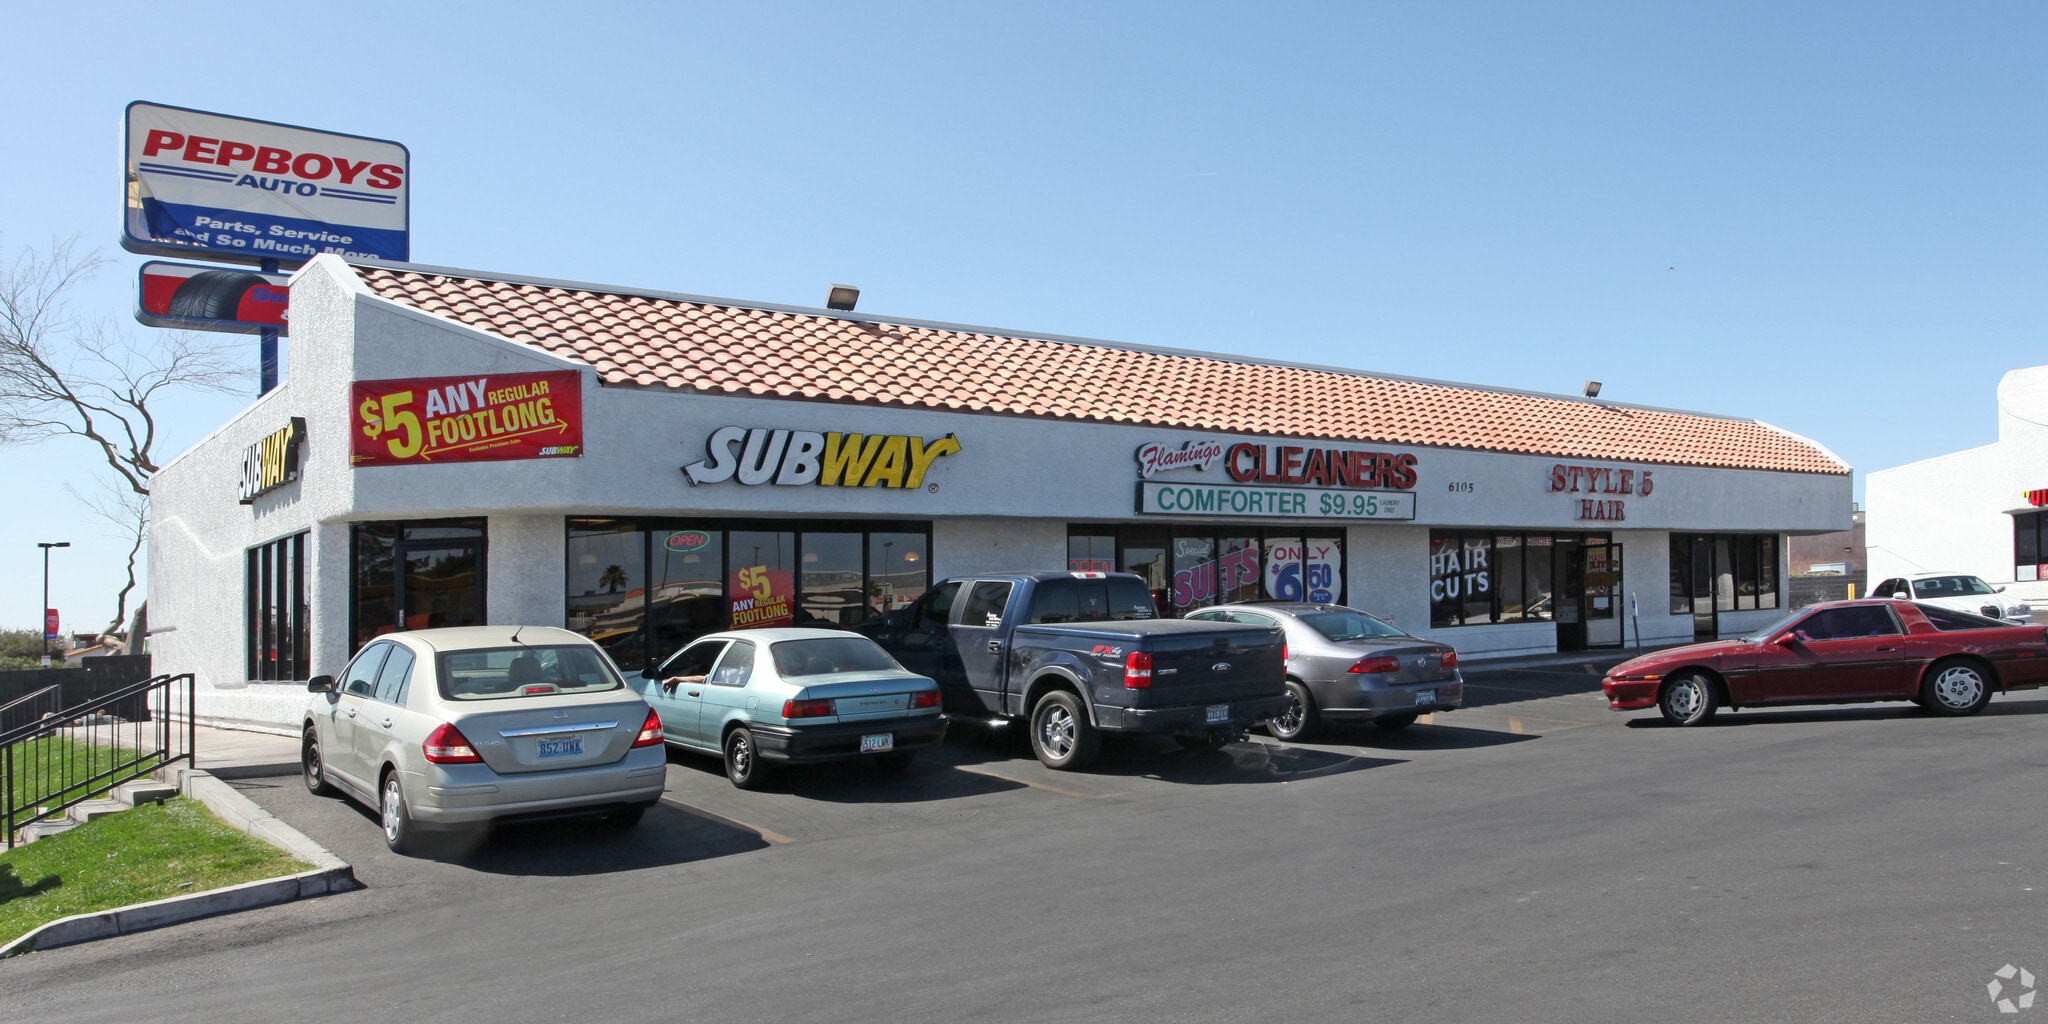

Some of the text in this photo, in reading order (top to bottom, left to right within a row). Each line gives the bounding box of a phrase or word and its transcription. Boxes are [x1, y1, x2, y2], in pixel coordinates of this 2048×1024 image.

[143, 129, 404, 190] PEPBOYS
[235, 173, 318, 197] AUTO
[195, 216, 353, 244] Parts, Service
[216, 234, 246, 248] So
[253, 238, 316, 256] Much
[360, 379, 550, 458] $5 ANY REGULAR
[427, 397, 556, 448] FOOTLONG
[469, 444, 489, 453] Excludes
[490, 440, 509, 449] Premium
[539, 446, 576, 456] SUBWAY
[681, 425, 962, 489] SUBWAY
[239, 422, 294, 500] SUBWAY
[1142, 442, 1418, 489] Flamingo CLEANERS
[1448, 481, 1474, 494] 6105
[1551, 464, 1654, 497] STYLE 5
[1157, 487, 1378, 517] COMFORTER $9.95
[1580, 498, 1626, 521] HAIR
[669, 534, 704, 547] OPEN
[1176, 540, 1210, 558] Special
[1274, 547, 1330, 560] ONLY
[1431, 547, 1488, 576] HAIR
[739, 565, 771, 600] $5
[1174, 548, 1261, 608] SUITS
[1431, 571, 1489, 602] CUTS
[732, 603, 789, 625] FOOTLONG
[733, 595, 786, 613] ANY REGULAR
[1092, 645, 1122, 655] FX4
